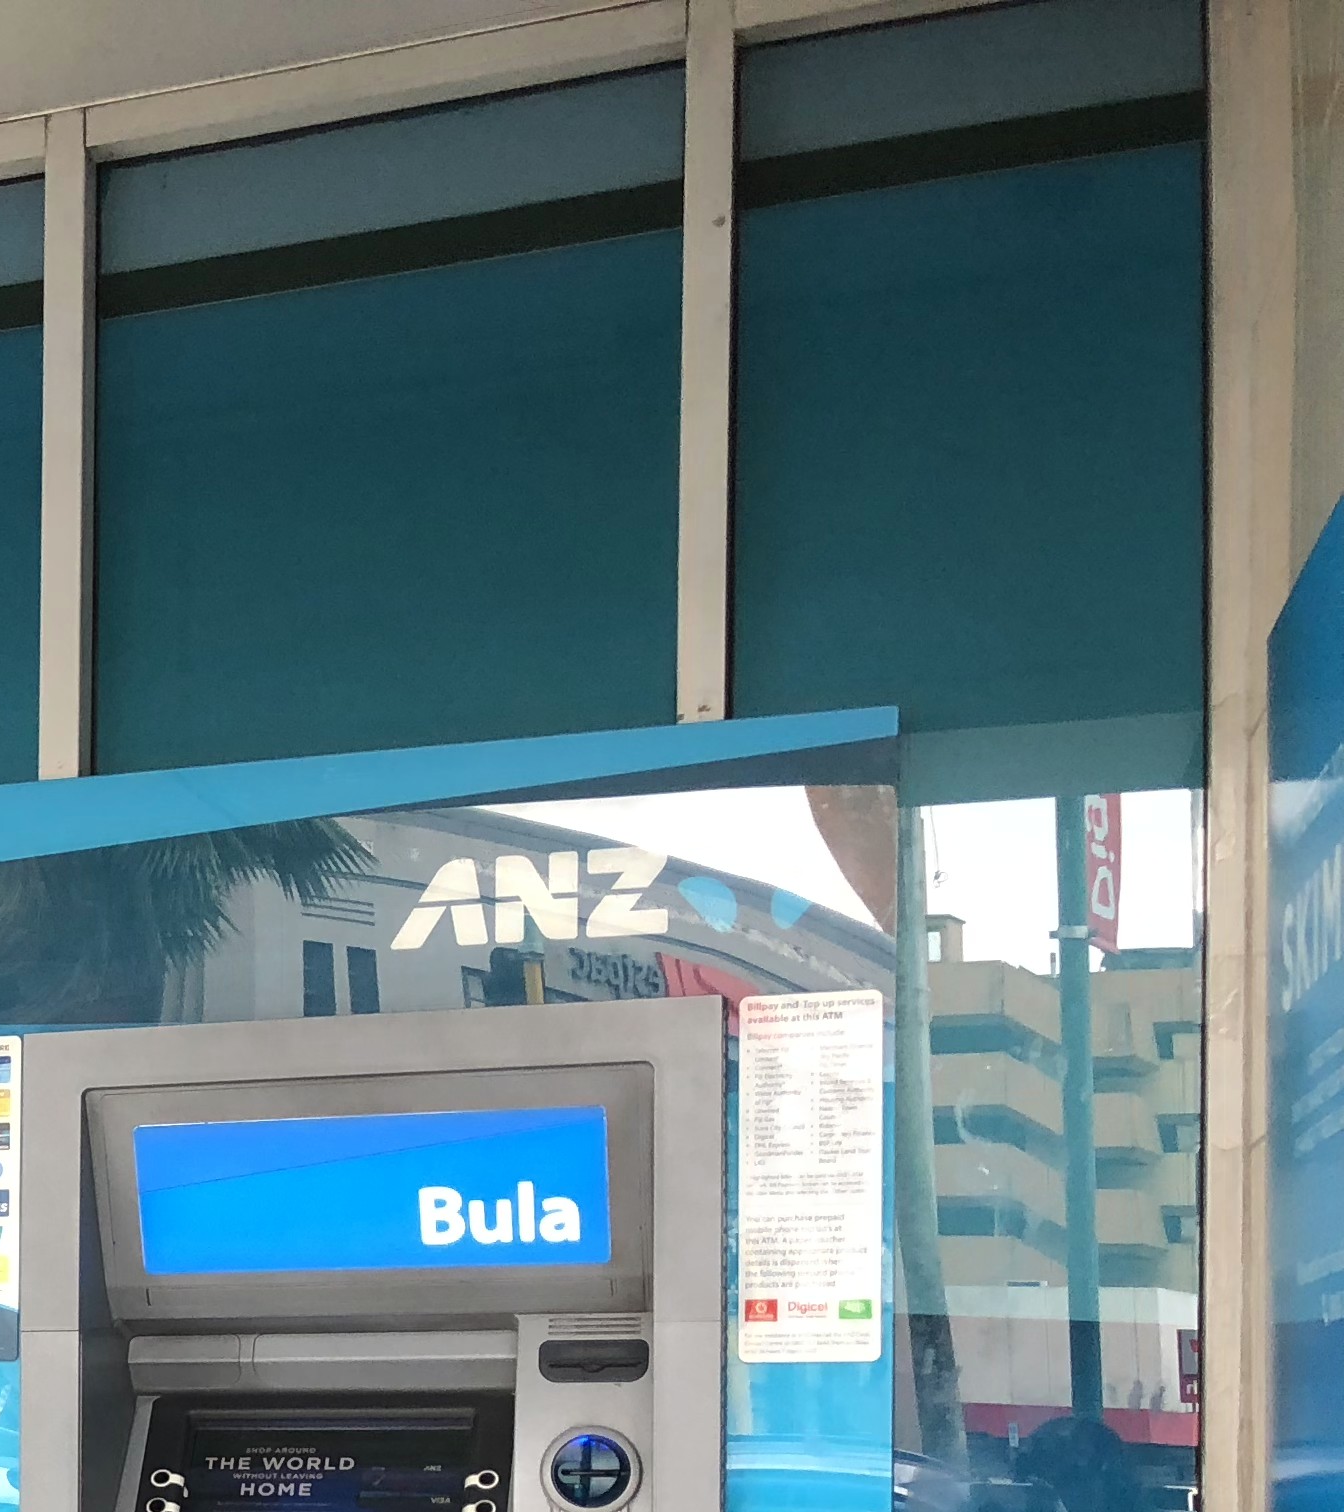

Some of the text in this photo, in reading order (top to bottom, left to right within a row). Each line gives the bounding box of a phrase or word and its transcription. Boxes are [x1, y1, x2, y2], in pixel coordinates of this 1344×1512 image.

[390, 847, 669, 951] ANZ
[747, 998, 875, 1012] Billpay and Top up services
[747, 1011, 843, 1024] available at this ATM
[417, 1179, 582, 1248] Bula
[787, 1301, 828, 1314] Digicel
[205, 1456, 355, 1471] THE WORLD
[280, 1472, 324, 1480] LEAVING
[240, 1482, 312, 1497] HOME
